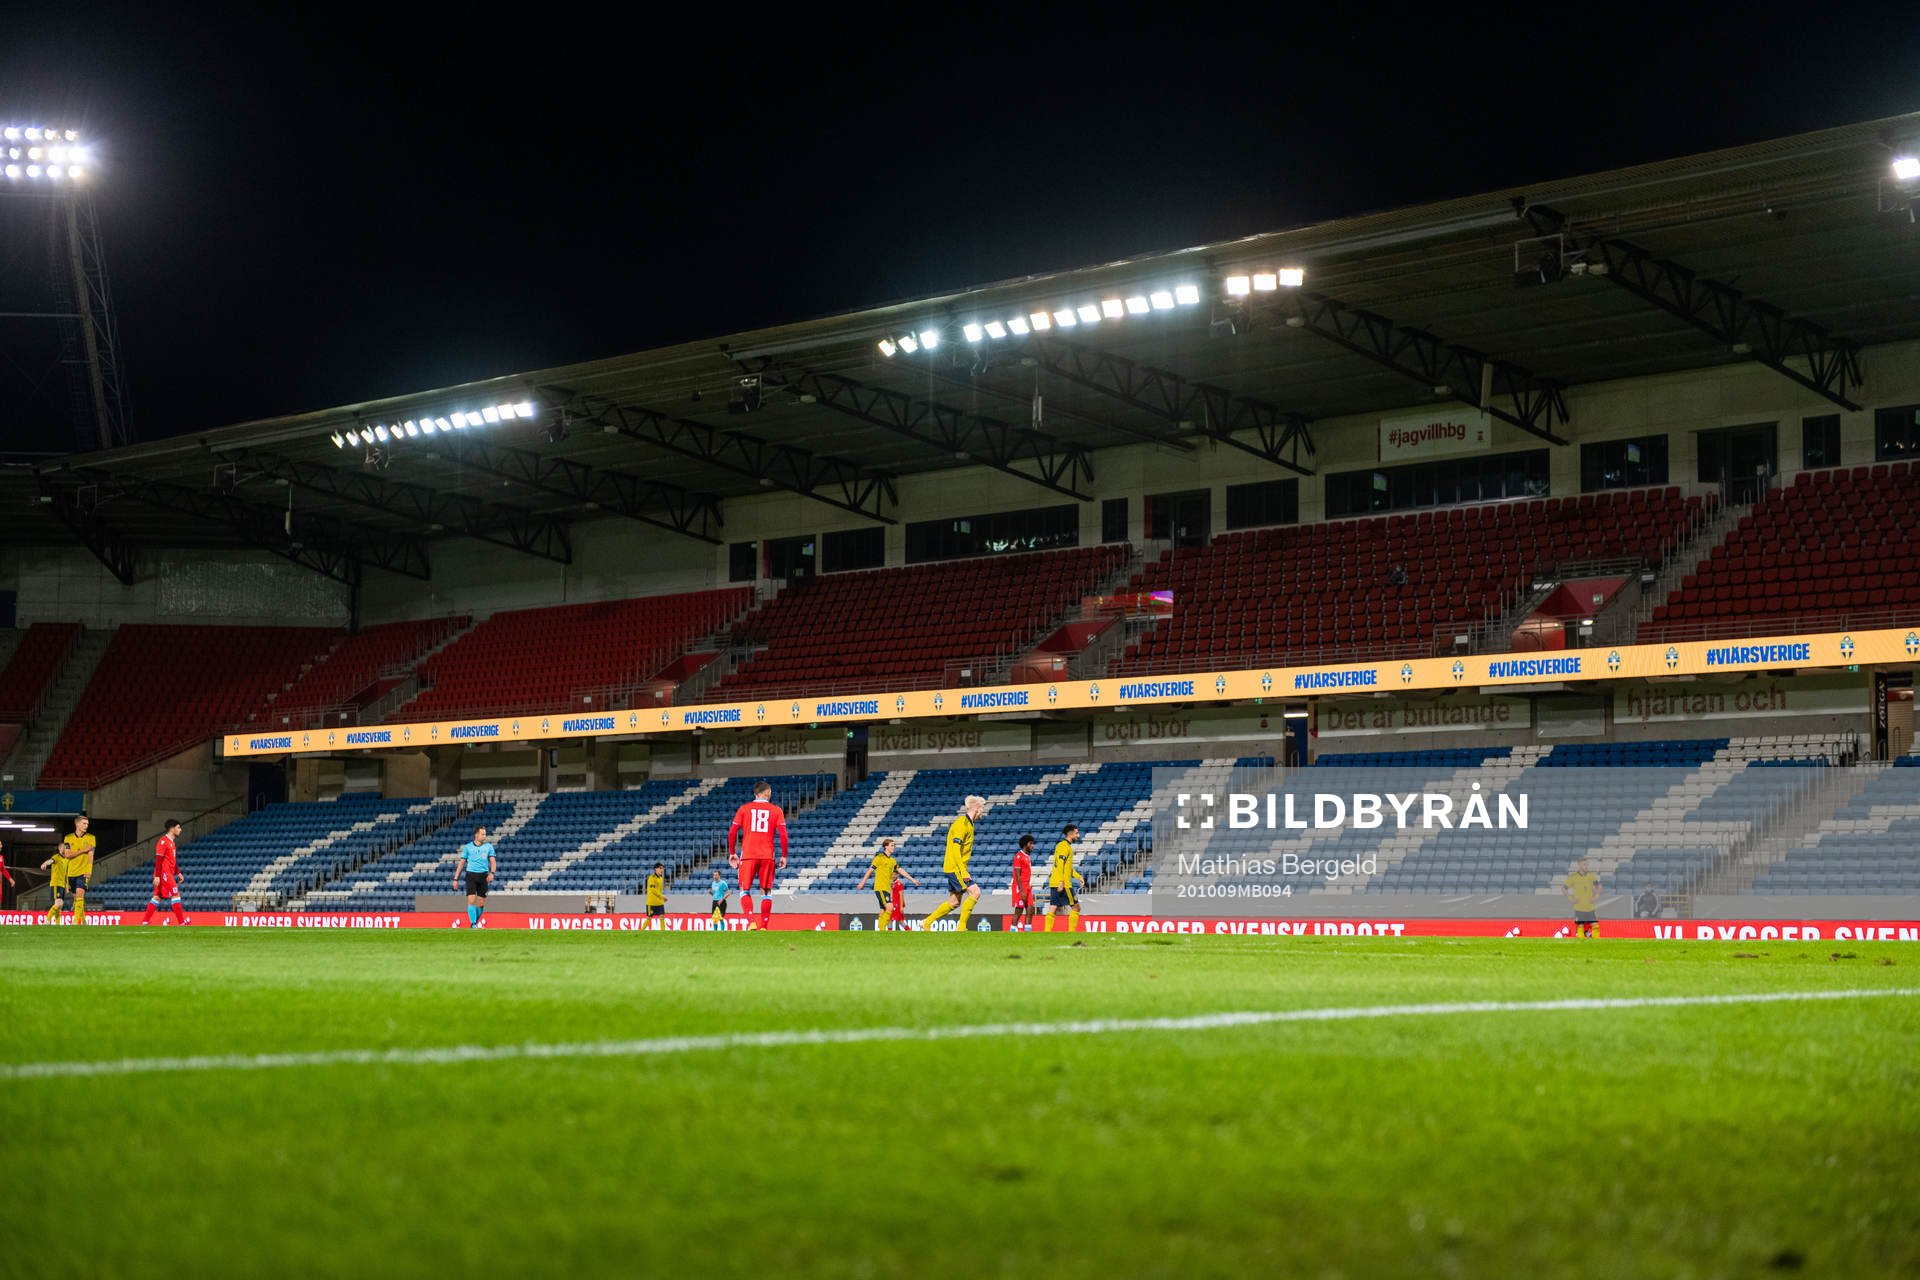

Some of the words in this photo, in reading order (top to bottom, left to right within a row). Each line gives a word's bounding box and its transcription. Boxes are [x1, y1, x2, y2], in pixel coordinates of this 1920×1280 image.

[1389, 422, 1466, 448] #jagvillhbg
[1706, 643, 1811, 665] #VIÄRSVERIGE
[1488, 657, 1581, 678] #VIÄRSVERIGE
[1294, 669, 1377, 689] #VIÄRSVERIGE
[1119, 680, 1194, 699] #VIÄRSVERIGE
[816, 700, 878, 717] #VIÄRSVERIGE
[961, 691, 1029, 709] #VIÄRSVERIGE
[1627, 688, 1725, 720] hjärtan
[1734, 682, 1787, 711] och
[684, 708, 741, 725] #VIÄRSVERIGE
[1328, 707, 1366, 730] Det
[1373, 704, 1394, 728] är
[1404, 697, 1511, 727] bultande
[450, 724, 499, 738] #VIÄRSVERIGE
[562, 717, 615, 732] #VIÄRSVERIGE
[1105, 717, 1142, 740] och
[249, 737, 292, 749] #VIÄRSVERIGE
[346, 731, 391, 744] #VIÄRSVERIGE
[705, 739, 732, 758] Det
[737, 735, 753, 756] är
[758, 734, 808, 756] kärlek
[875, 728, 922, 751] ikväll
[928, 729, 985, 752] syster
[750, 808, 770, 833] 18
